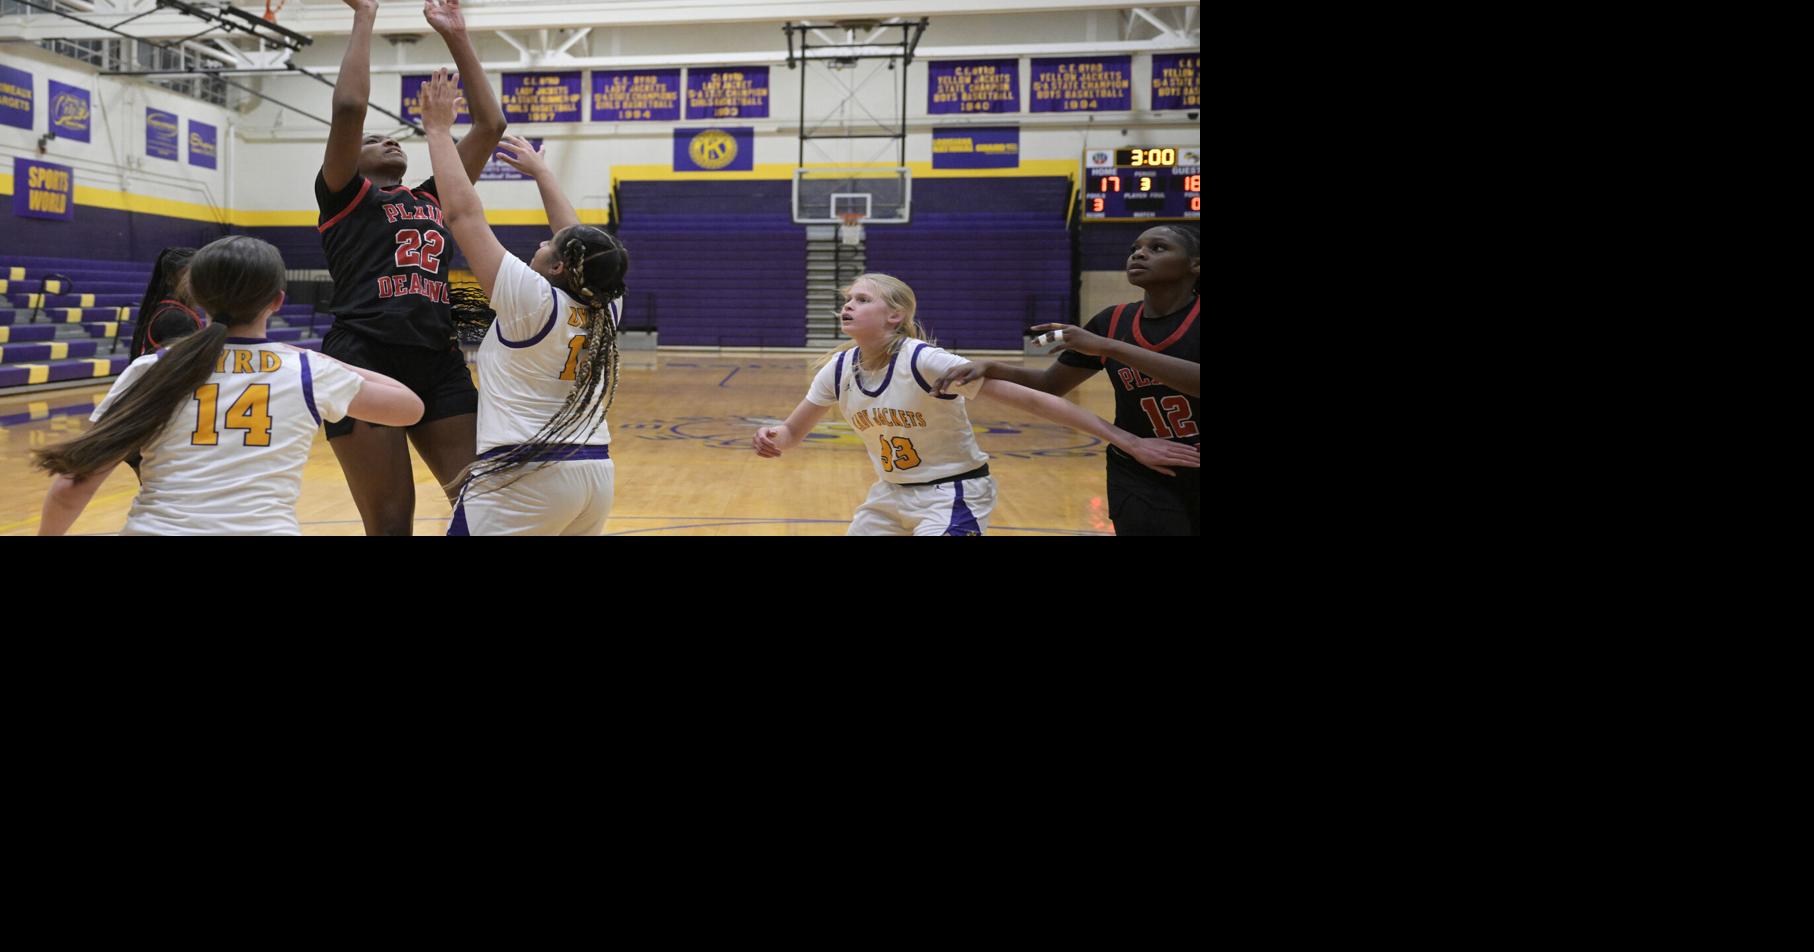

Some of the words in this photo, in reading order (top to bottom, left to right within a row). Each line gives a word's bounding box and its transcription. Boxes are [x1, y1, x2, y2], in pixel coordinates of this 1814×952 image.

[972, 66, 995, 75] BYRD
[1079, 63, 1103, 73] BYRD
[1163, 69, 1194, 78] YELLOW
[633, 75, 657, 84] BYRD
[938, 76, 971, 84] YELLOW
[973, 74, 1010, 83] JACKETS
[1041, 72, 1077, 83] YELLOW
[1080, 71, 1121, 81] JACKETS
[1051, 81, 1078, 90] STATE
[934, 92, 958, 103] BOYS
[1037, 90, 1061, 100] BOYS
[1065, 89, 1123, 99] BASKETBALL
[1131, 148, 1175, 166] 3:00
[1091, 168, 1117, 176] HOME
[28, 166, 69, 193] SPORTS
[1101, 176, 1120, 192] 17
[1140, 177, 1151, 191] 3
[1184, 175, 1200, 192] 18
[29, 189, 66, 214] WORLD
[1093, 198, 1104, 212] 3
[395, 229, 445, 274] 22
[214, 348, 282, 374] YRD
[191, 383, 273, 447] 14
[872, 407, 927, 428] JACKETS
[1140, 395, 1199, 438] 12
